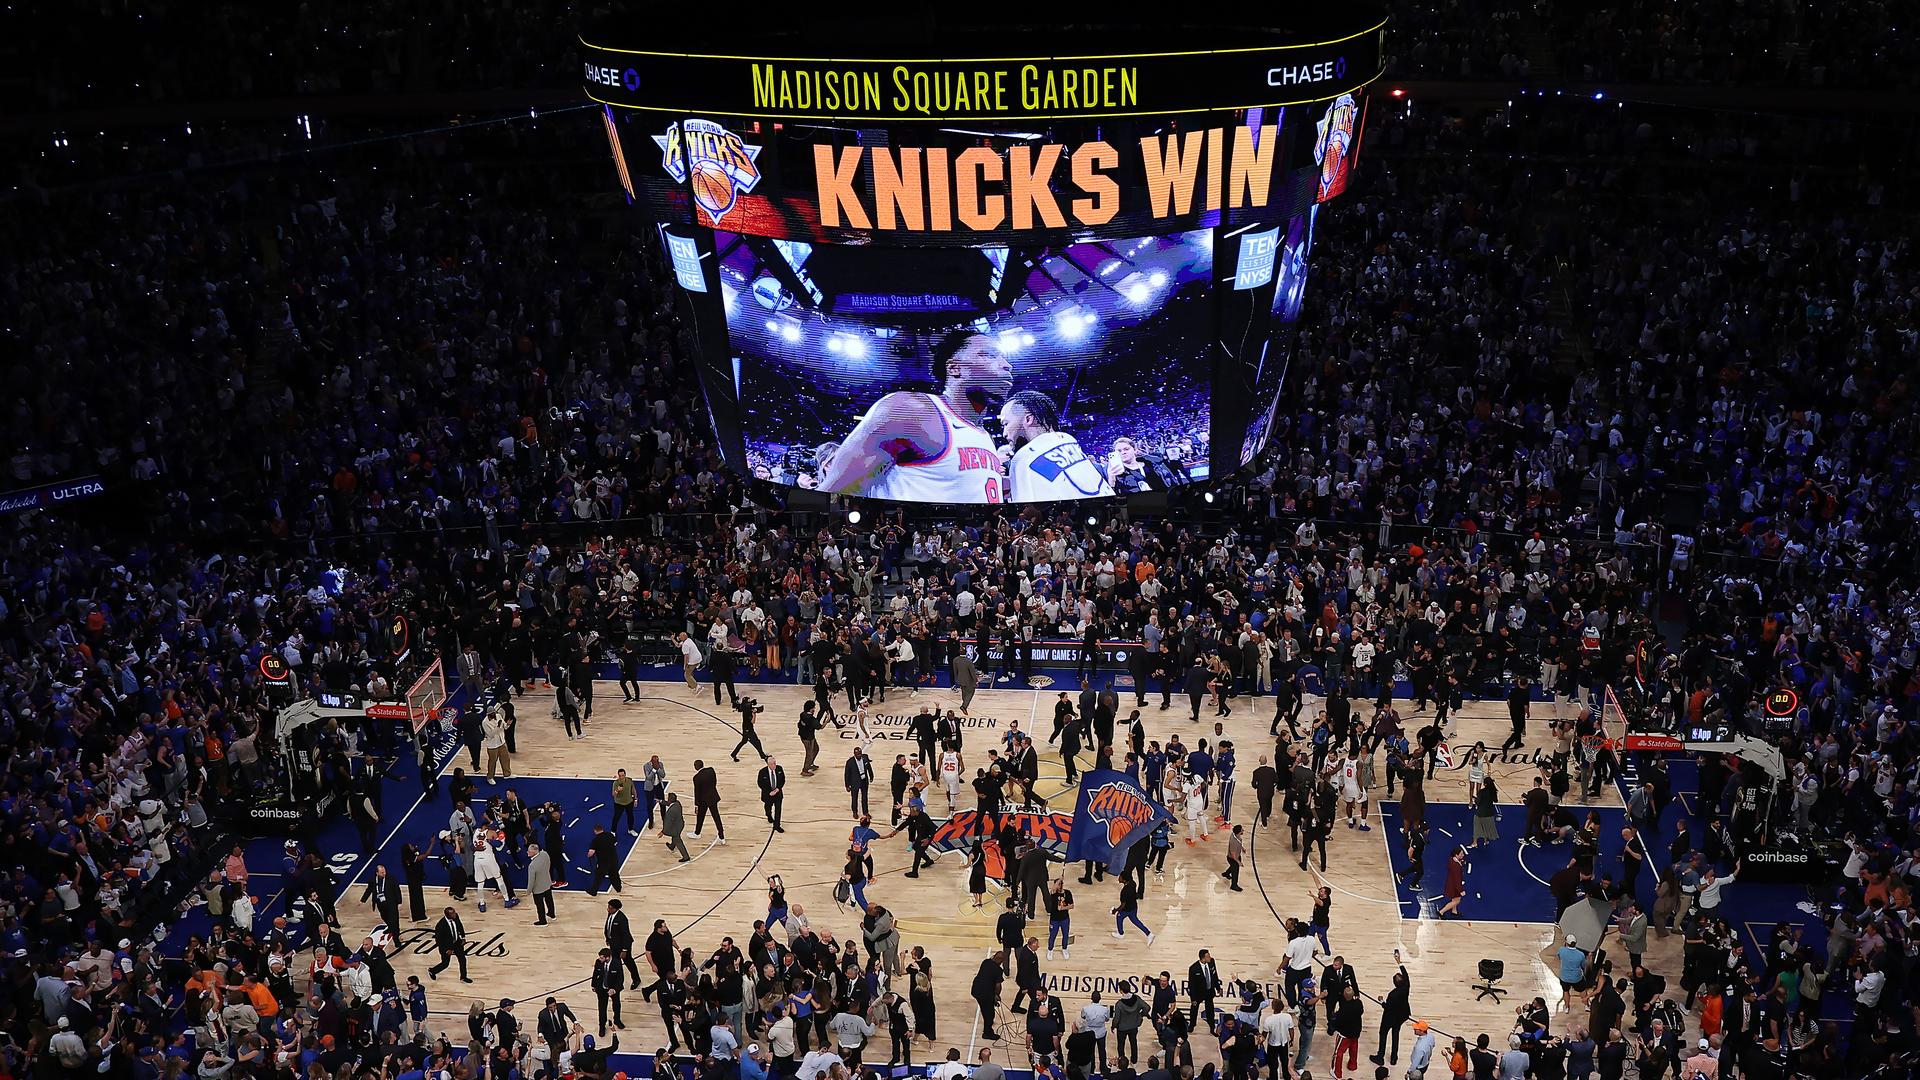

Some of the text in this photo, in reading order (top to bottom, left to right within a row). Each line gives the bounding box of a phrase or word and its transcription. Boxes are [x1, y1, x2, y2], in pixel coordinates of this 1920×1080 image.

[585, 62, 621, 87] CHASE
[1267, 61, 1334, 87] CHASE
[752, 64, 1137, 116] MADISON SQUARE GARDEN
[665, 126, 759, 178] KNICKS
[813, 124, 1278, 231] KNICKS WIN
[1246, 233, 1277, 256] TEN
[1240, 265, 1271, 286] NYSE
[53, 482, 104, 500] ULTRA
[1015, 648, 1050, 661] SRDAY
[1051, 649, 1071, 661] GAME
[1071, 650, 1077, 661] 5
[392, 709, 407, 717] Farm
[1698, 728, 1712, 740] App
[1647, 740, 1664, 748] State
[944, 762, 956, 772] 25
[1346, 768, 1353, 778] 8
[1748, 851, 1808, 863] coinbase
[386, 927, 511, 958] Fials
